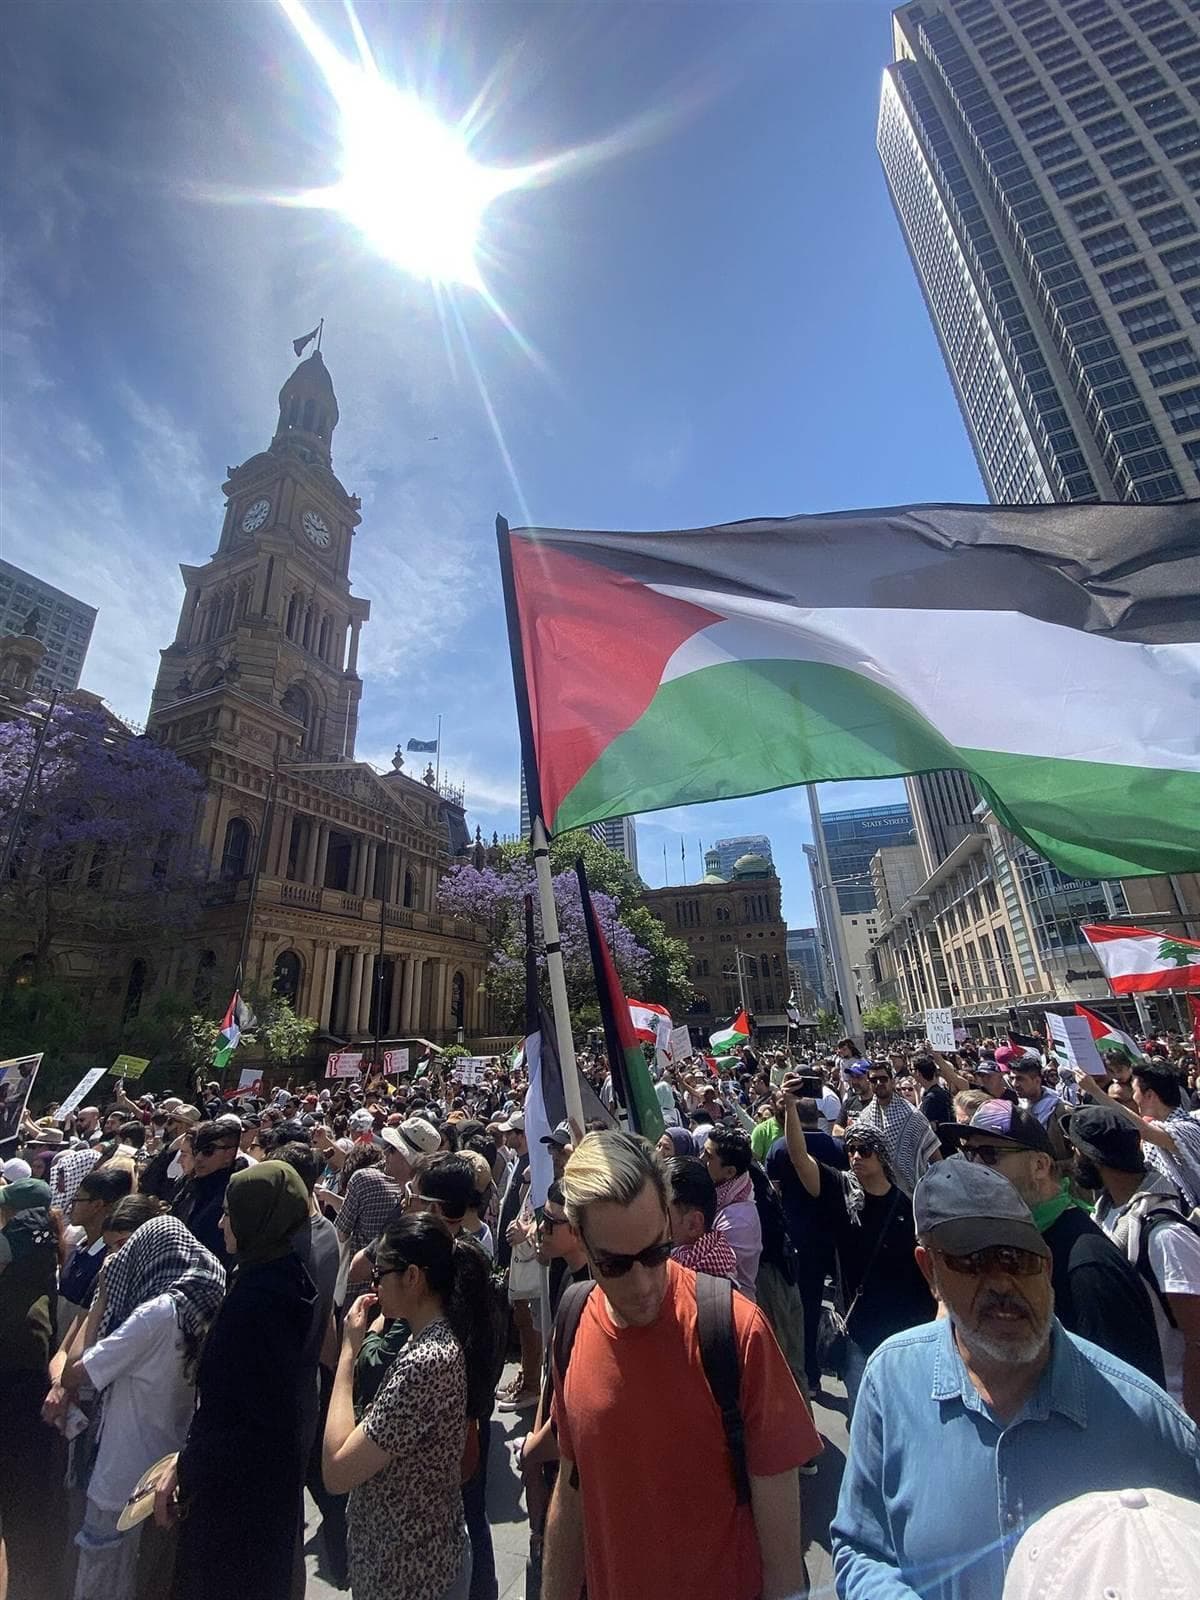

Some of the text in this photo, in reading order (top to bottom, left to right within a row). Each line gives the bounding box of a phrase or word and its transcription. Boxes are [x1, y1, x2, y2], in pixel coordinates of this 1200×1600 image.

[862, 817, 909, 828] STATE STREET
[926, 1012, 951, 1024] PEACE
[931, 1033, 952, 1045] LOVE
